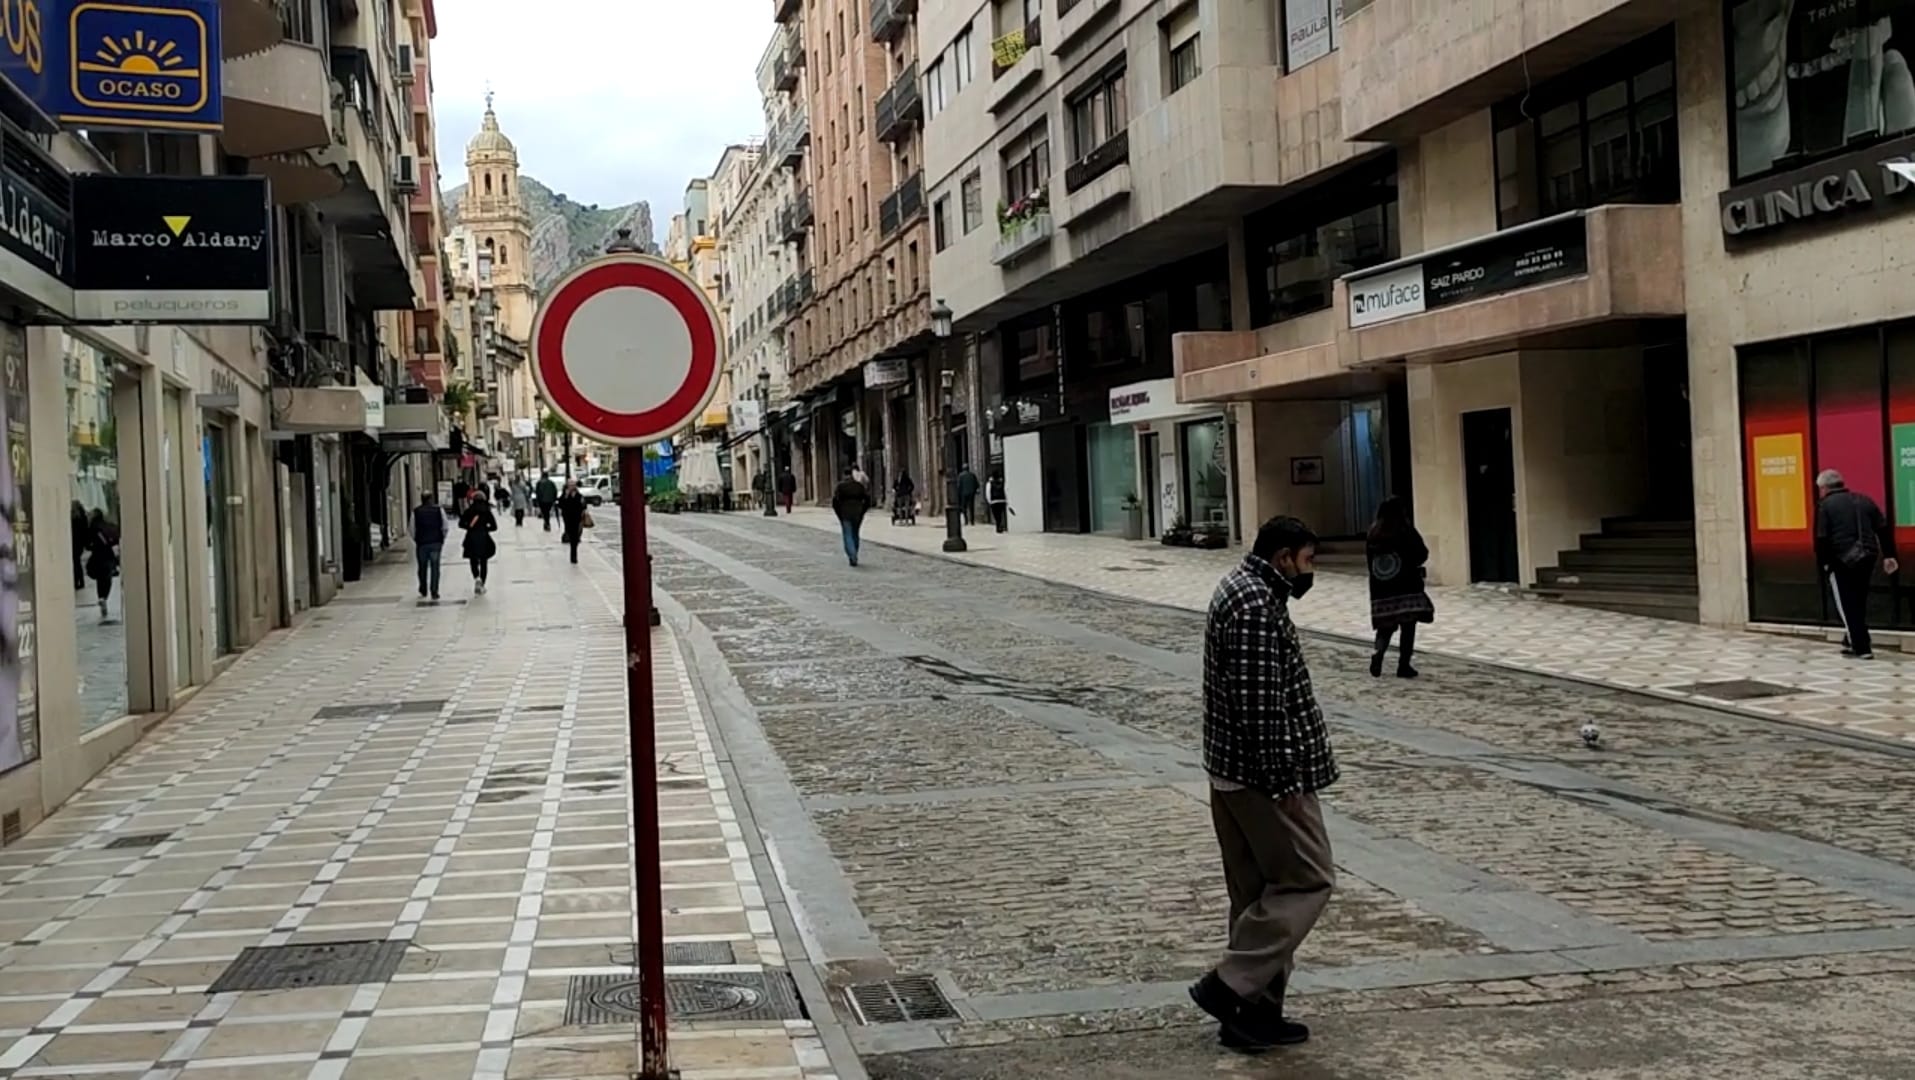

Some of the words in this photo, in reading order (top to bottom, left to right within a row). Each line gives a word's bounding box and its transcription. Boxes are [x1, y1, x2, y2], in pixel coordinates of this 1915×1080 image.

[0, 0, 41, 74] OS
[99, 79, 181, 98] OCASO
[92, 229, 171, 247] Marco
[183, 230, 263, 250] Aldany
[1451, 266, 1485, 285] PARDO
[114, 299, 239, 313] peluqueros
[1366, 283, 1421, 312] muface
